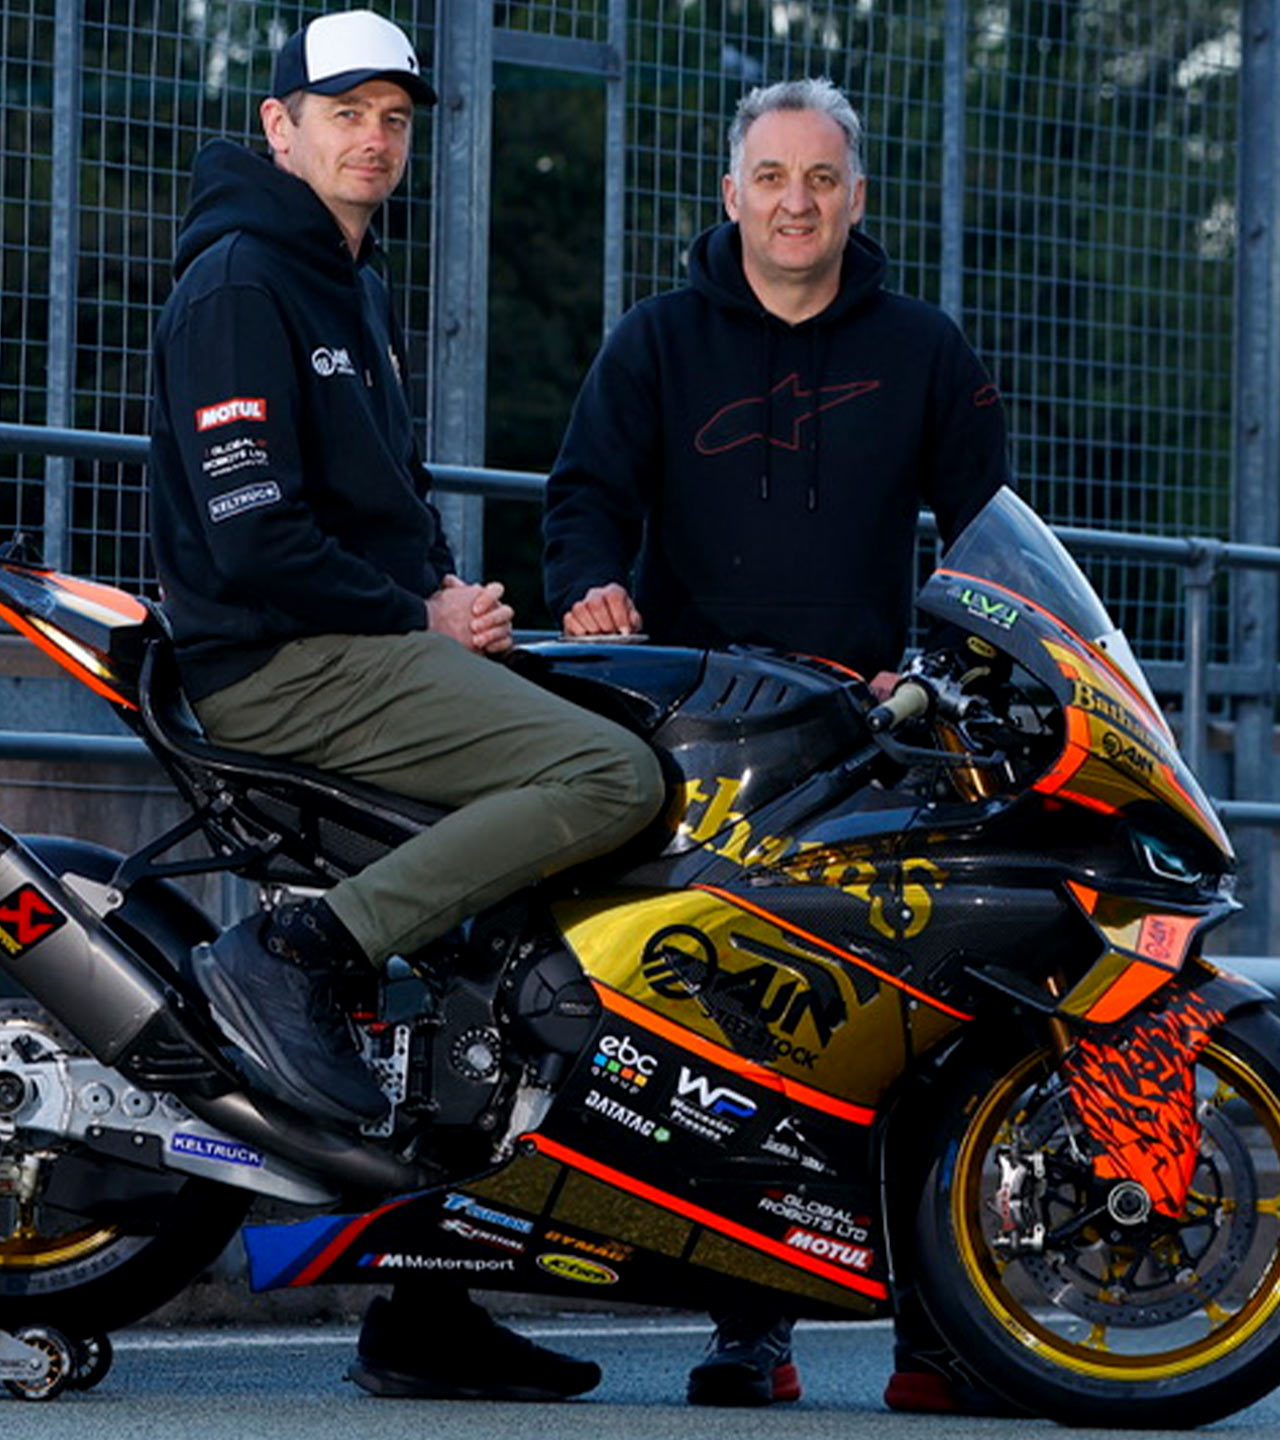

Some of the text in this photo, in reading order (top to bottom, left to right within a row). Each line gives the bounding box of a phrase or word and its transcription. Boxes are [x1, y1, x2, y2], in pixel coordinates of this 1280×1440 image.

[199, 400, 262, 428] MOTUL
[599, 1035, 658, 1076] ebc
[591, 1066, 640, 1094] group
[585, 1089, 657, 1138] DATATAG
[173, 1137, 261, 1164] KELTRUCK
[757, 1197, 869, 1243] ROBOTS LTD
[782, 1193, 855, 1226] GLOBAL
[405, 1253, 516, 1272] Motorsport
[787, 1231, 869, 1269] MOTUL
